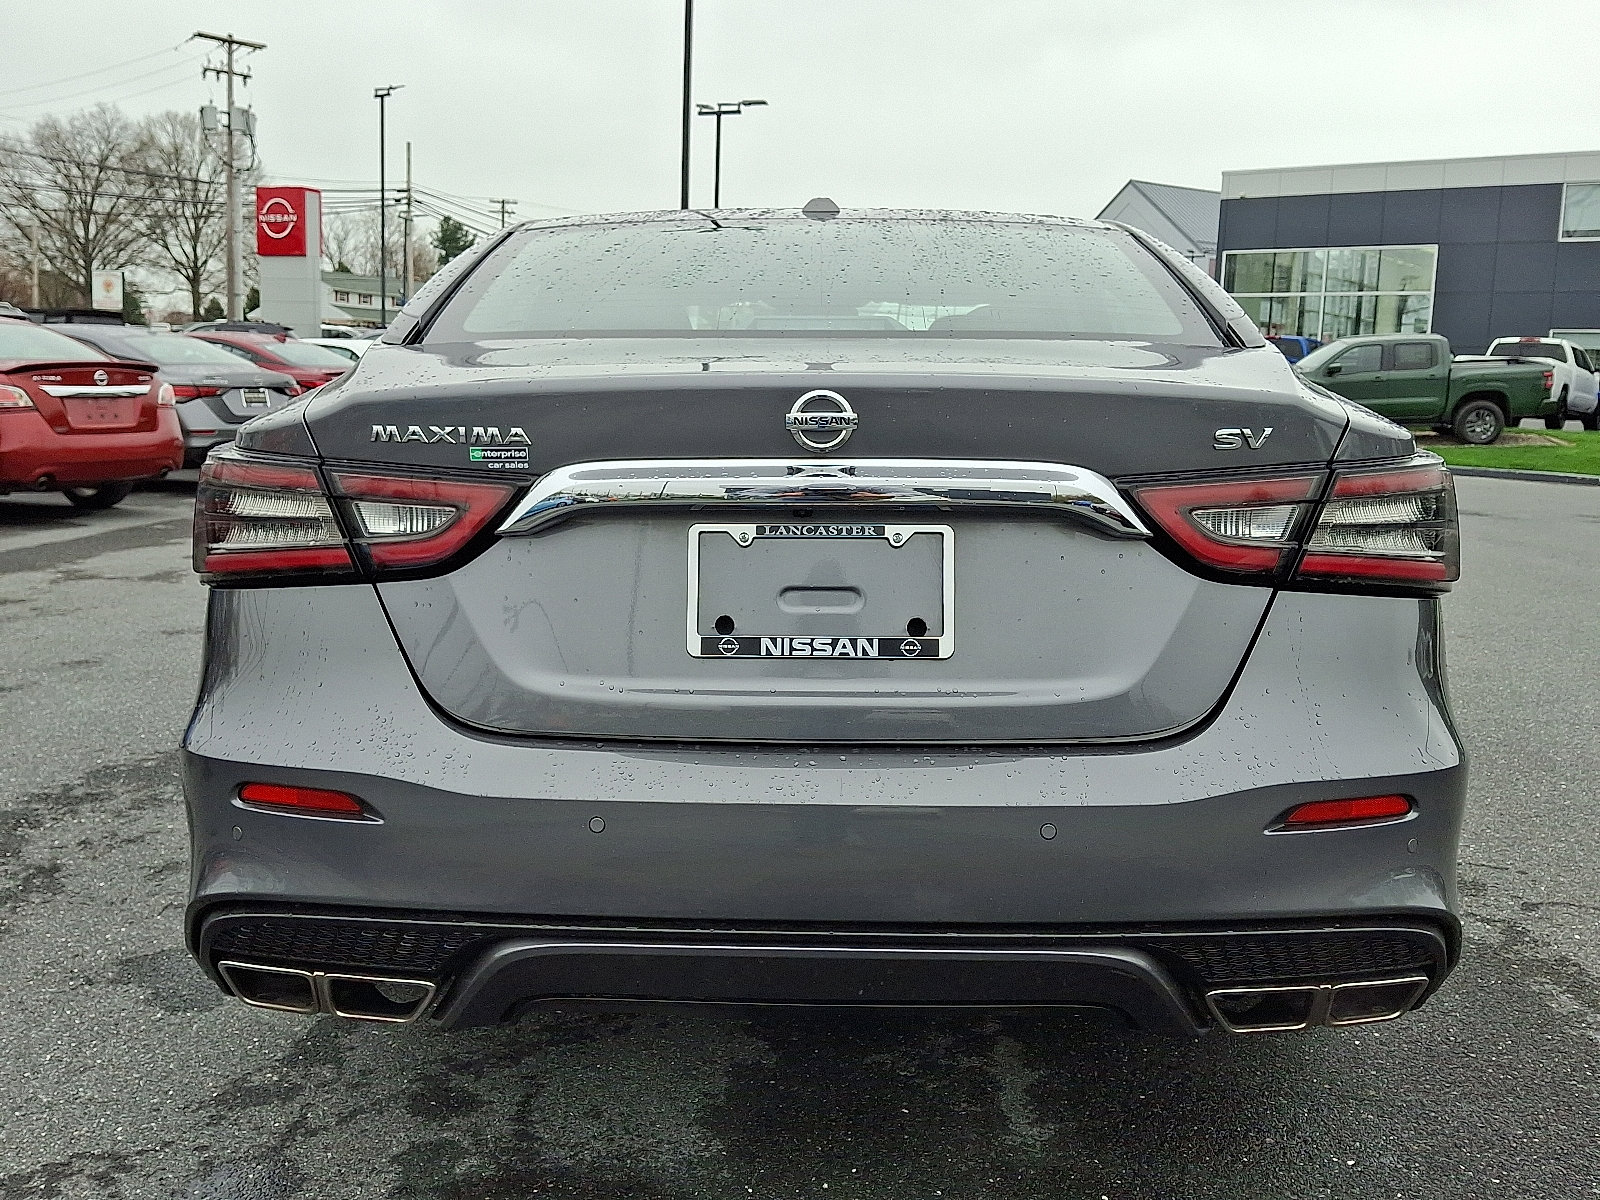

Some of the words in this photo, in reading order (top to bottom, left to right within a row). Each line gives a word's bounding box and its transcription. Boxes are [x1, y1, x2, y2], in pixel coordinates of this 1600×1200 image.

[259, 214, 298, 222] NISSAN
[793, 416, 851, 426] NISSAN
[370, 425, 532, 445] MAXIMA
[1213, 427, 1274, 450] SV
[505, 461, 529, 469] sales
[763, 525, 878, 536] LANCASTER
[760, 637, 879, 657] NISSAN
